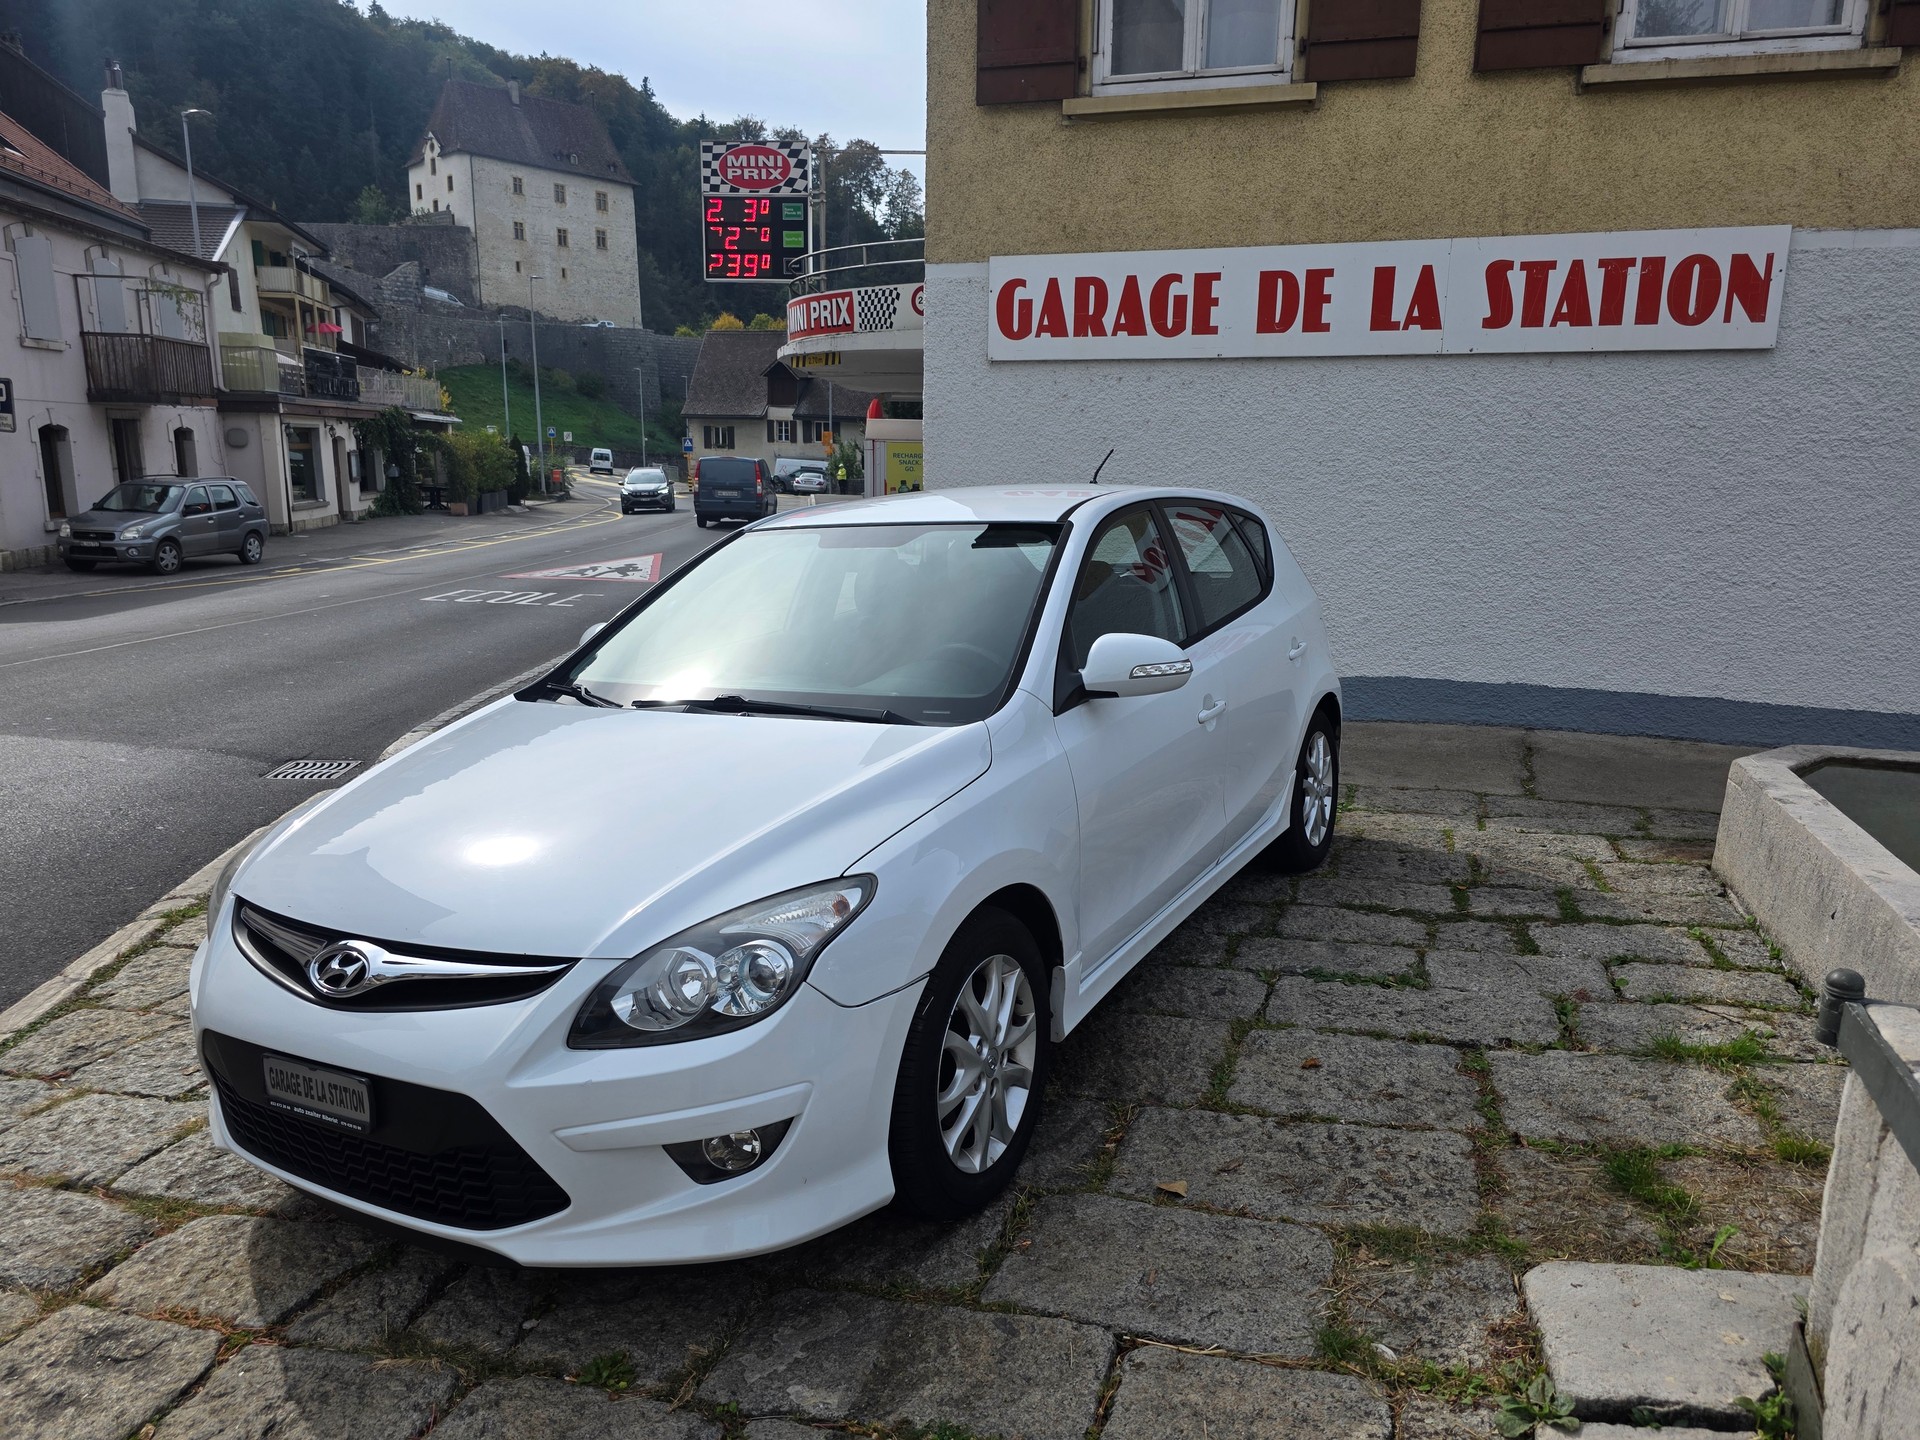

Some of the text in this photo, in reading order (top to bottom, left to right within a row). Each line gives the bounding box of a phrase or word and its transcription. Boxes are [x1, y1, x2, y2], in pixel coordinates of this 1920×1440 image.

[727, 155, 783, 167] MINI
[727, 168, 784, 180] PRIX
[996, 252, 1775, 341] GARAGE DE LA STATION
[789, 297, 851, 335] MINI PRIX
[420, 589, 604, 607] ECOLE
[269, 1067, 365, 1114] GARAGE DE LA STATION
